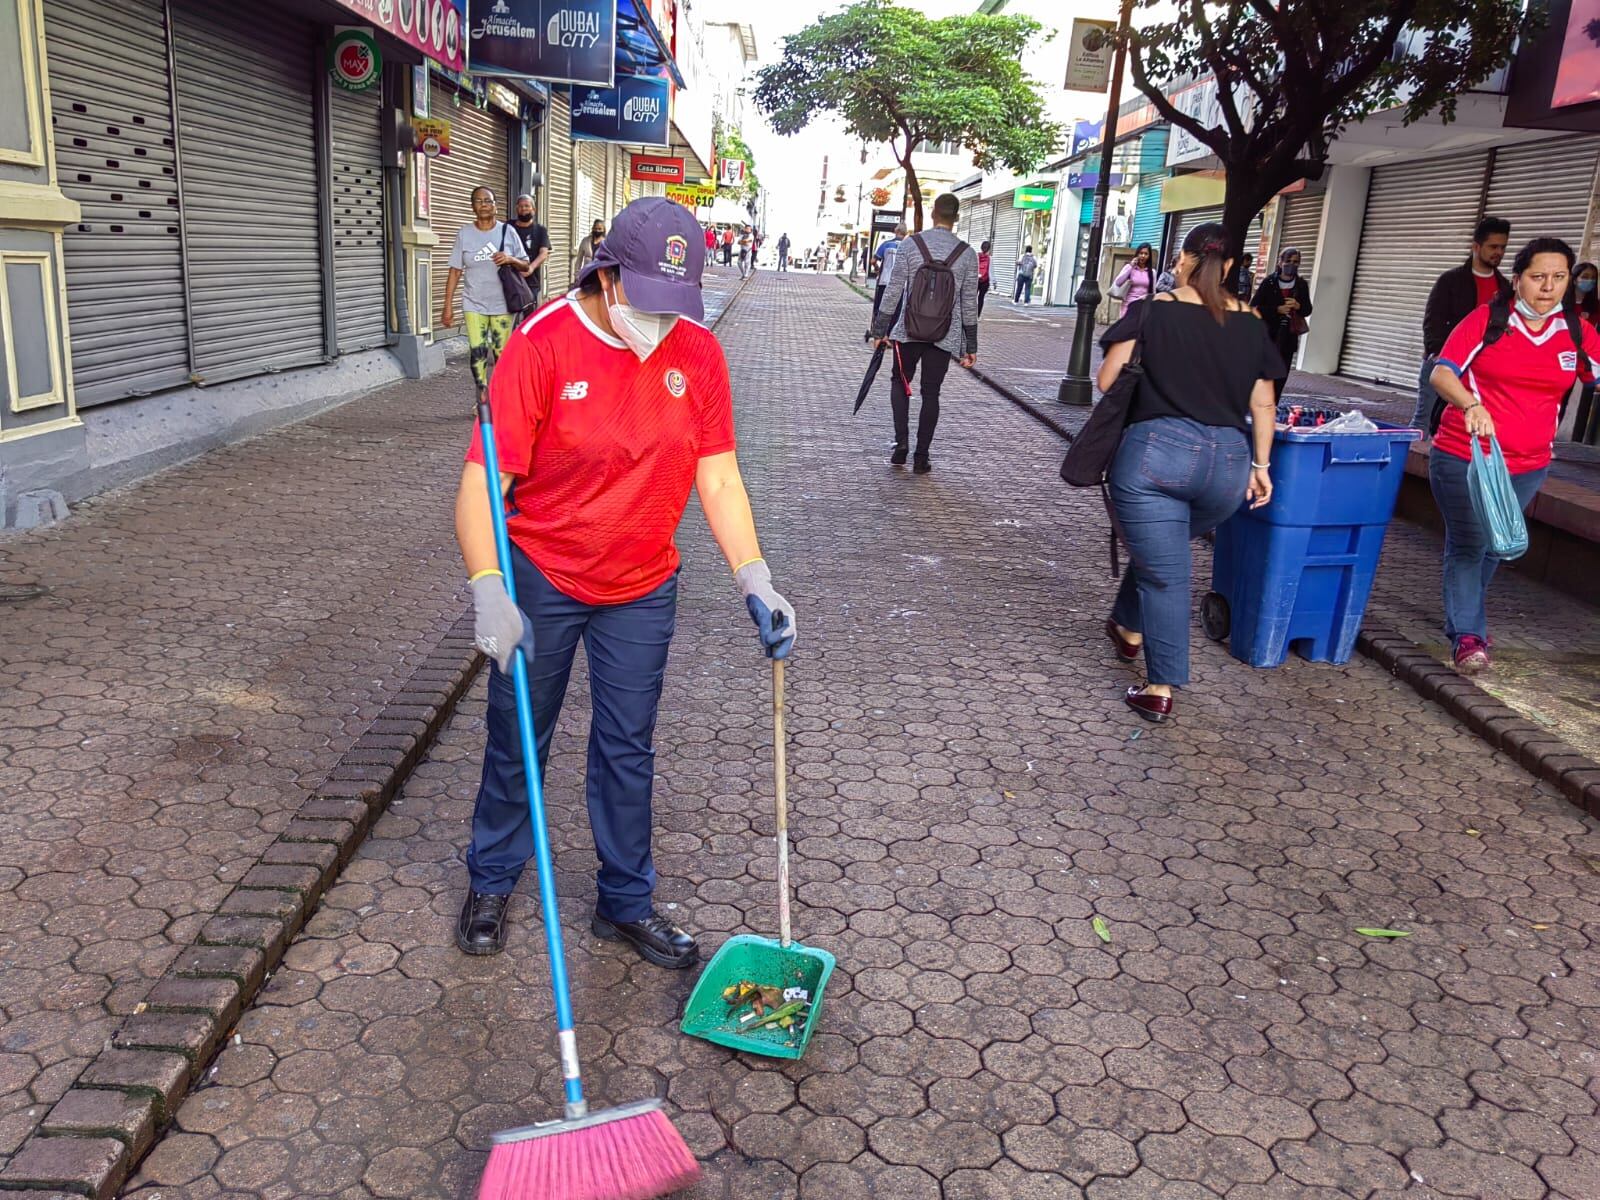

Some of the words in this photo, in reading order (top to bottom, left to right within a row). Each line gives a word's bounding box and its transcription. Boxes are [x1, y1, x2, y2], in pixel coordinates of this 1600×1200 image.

[560, 9, 600, 33] DUBAI
[470, 18, 536, 40] Jerusalem
[561, 32, 600, 49] CITY
[343, 59, 367, 73] MAX
[572, 103, 617, 117] Jerusalem
[632, 96, 660, 112] DUBAI
[633, 111, 660, 123] CITY
[637, 164, 654, 173] Casa
[655, 165, 679, 174] Blanca
[666, 191, 695, 206] COPIAS
